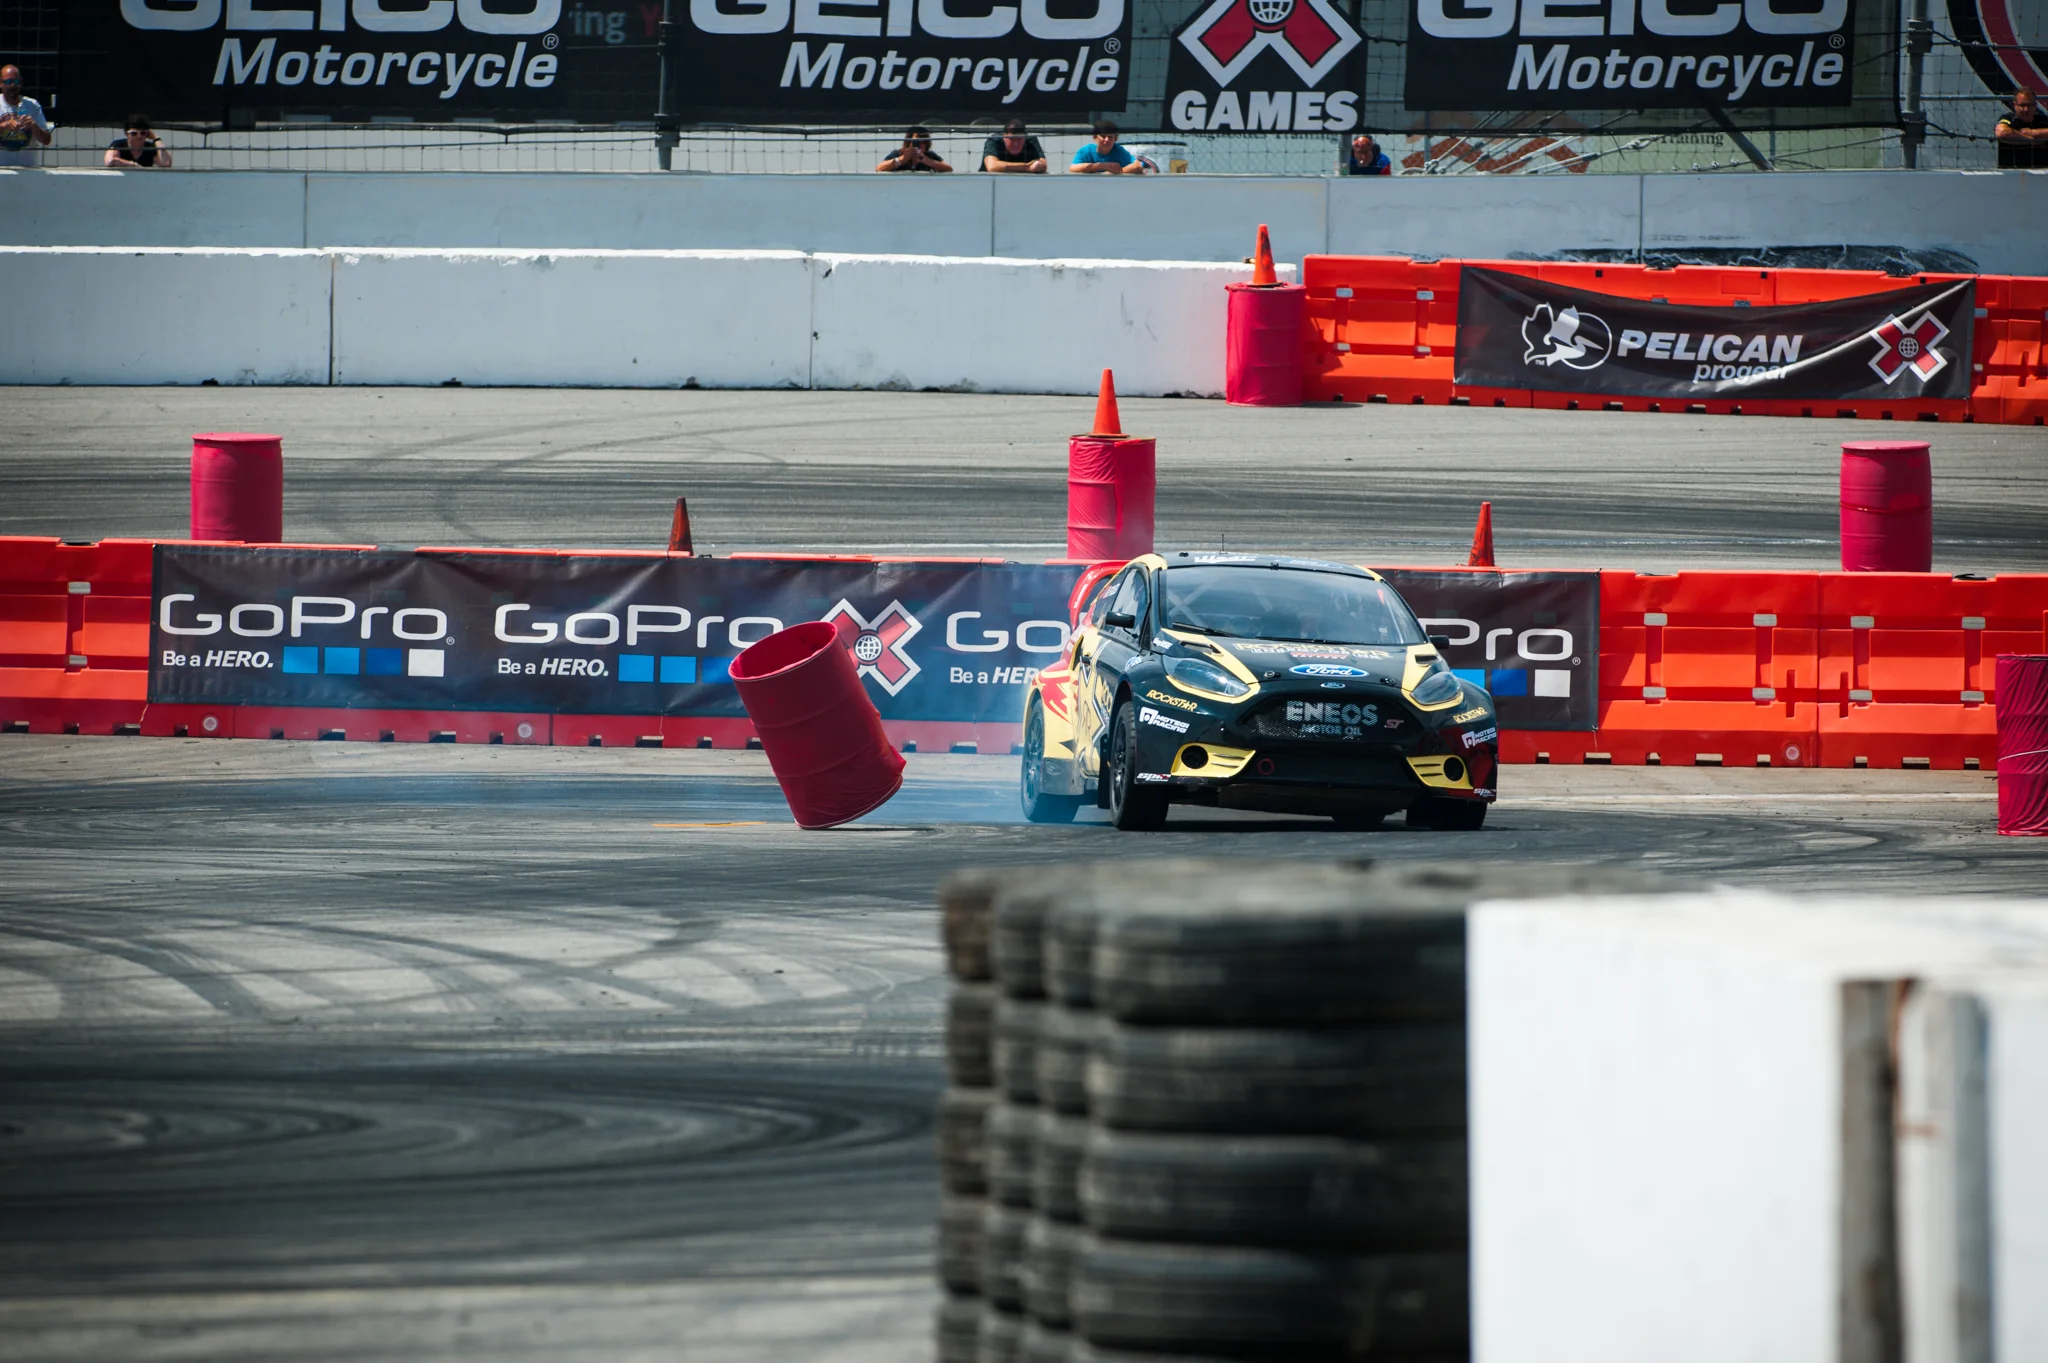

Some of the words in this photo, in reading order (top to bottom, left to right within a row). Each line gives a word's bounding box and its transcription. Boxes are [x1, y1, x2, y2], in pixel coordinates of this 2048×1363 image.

[211, 37, 559, 99] Motorcycle
[779, 41, 1121, 104] Motorcycle
[1507, 41, 1845, 101] Motorcycle
[1170, 89, 1360, 132] GAMES
[1616, 329, 1804, 363] PELICAN
[1692, 362, 1793, 384] progear
[159, 593, 448, 640] GoPro
[1417, 617, 1574, 661] Pro
[162, 650, 187, 667] Be
[189, 654, 202, 668] a
[204, 650, 274, 669] HERO.
[497, 658, 522, 675] Be
[524, 662, 537, 675] a
[539, 658, 609, 677] HERO.
[1305, 664, 1353, 676] Ford
[950, 666, 974, 683] Be
[977, 671, 989, 684] a
[1286, 700, 1378, 726] ENEOS
[1153, 719, 1189, 734] RACING
[1301, 723, 1342, 735] MOTOR
[1344, 726, 1363, 736] OIL
